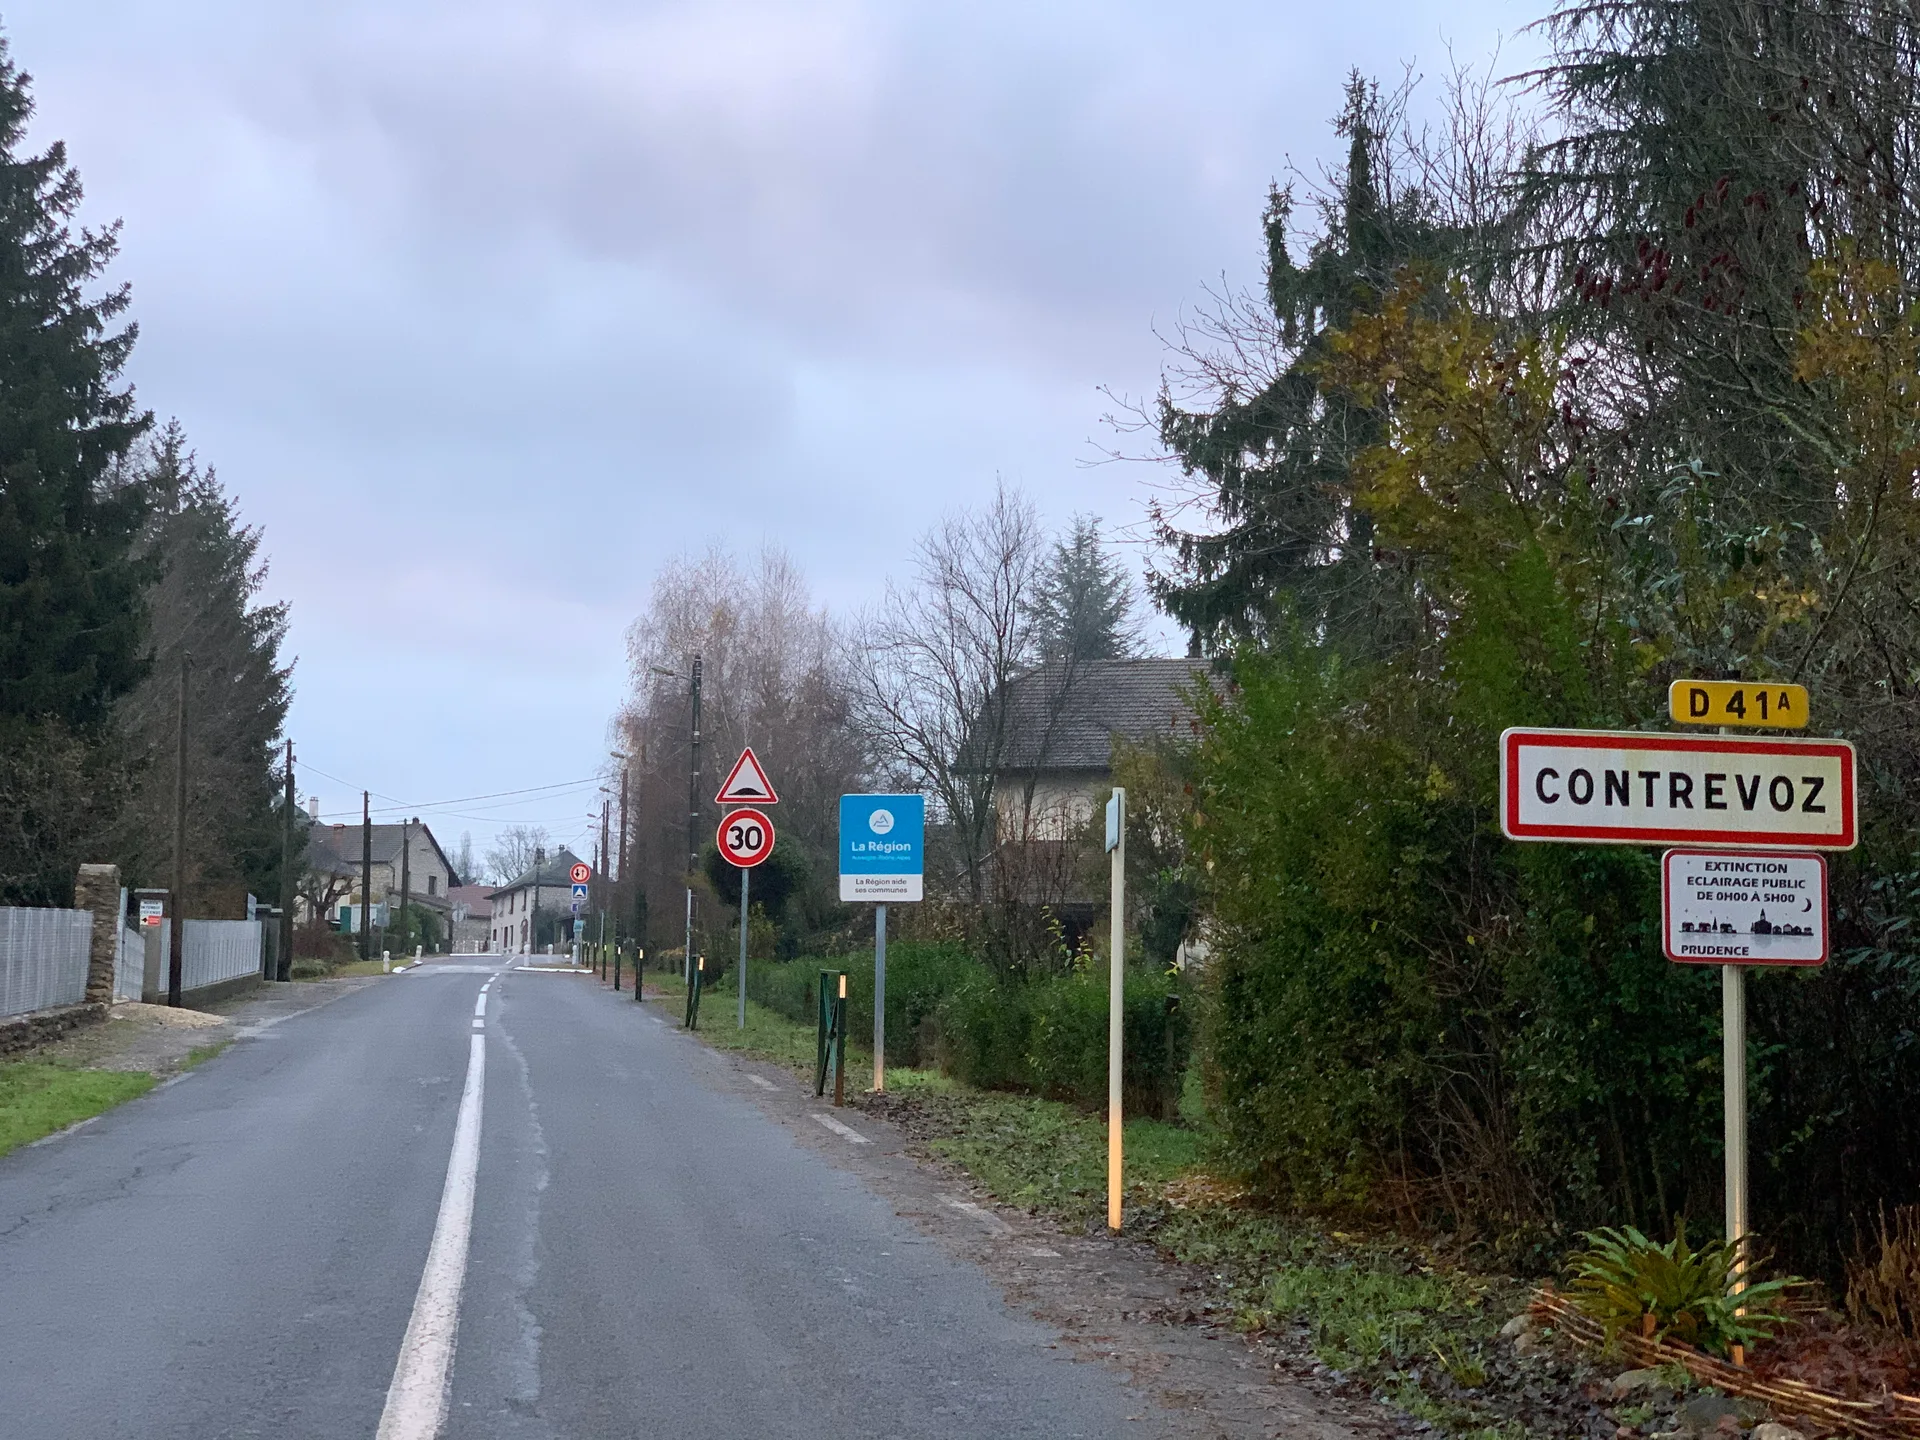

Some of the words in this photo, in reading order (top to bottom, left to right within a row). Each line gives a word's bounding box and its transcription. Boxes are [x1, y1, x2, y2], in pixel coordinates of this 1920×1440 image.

[1689, 688, 1710, 718] D
[1535, 767, 1826, 814] CONTREVOZ
[729, 825, 762, 850] 30
[851, 841, 866, 852] La
[868, 840, 911, 854] Région
[1704, 861, 1788, 874] EXTINCTION
[865, 878, 890, 886] Région
[1686, 876, 1759, 888] ECLAIRAGE
[1761, 878, 1806, 889] PUBLIC
[1696, 891, 1713, 901] DE
[1716, 892, 1748, 902] 0H00
[1750, 890, 1761, 902] À
[1763, 893, 1795, 903] 5H00
[1681, 944, 1750, 956] PRUDENCE
